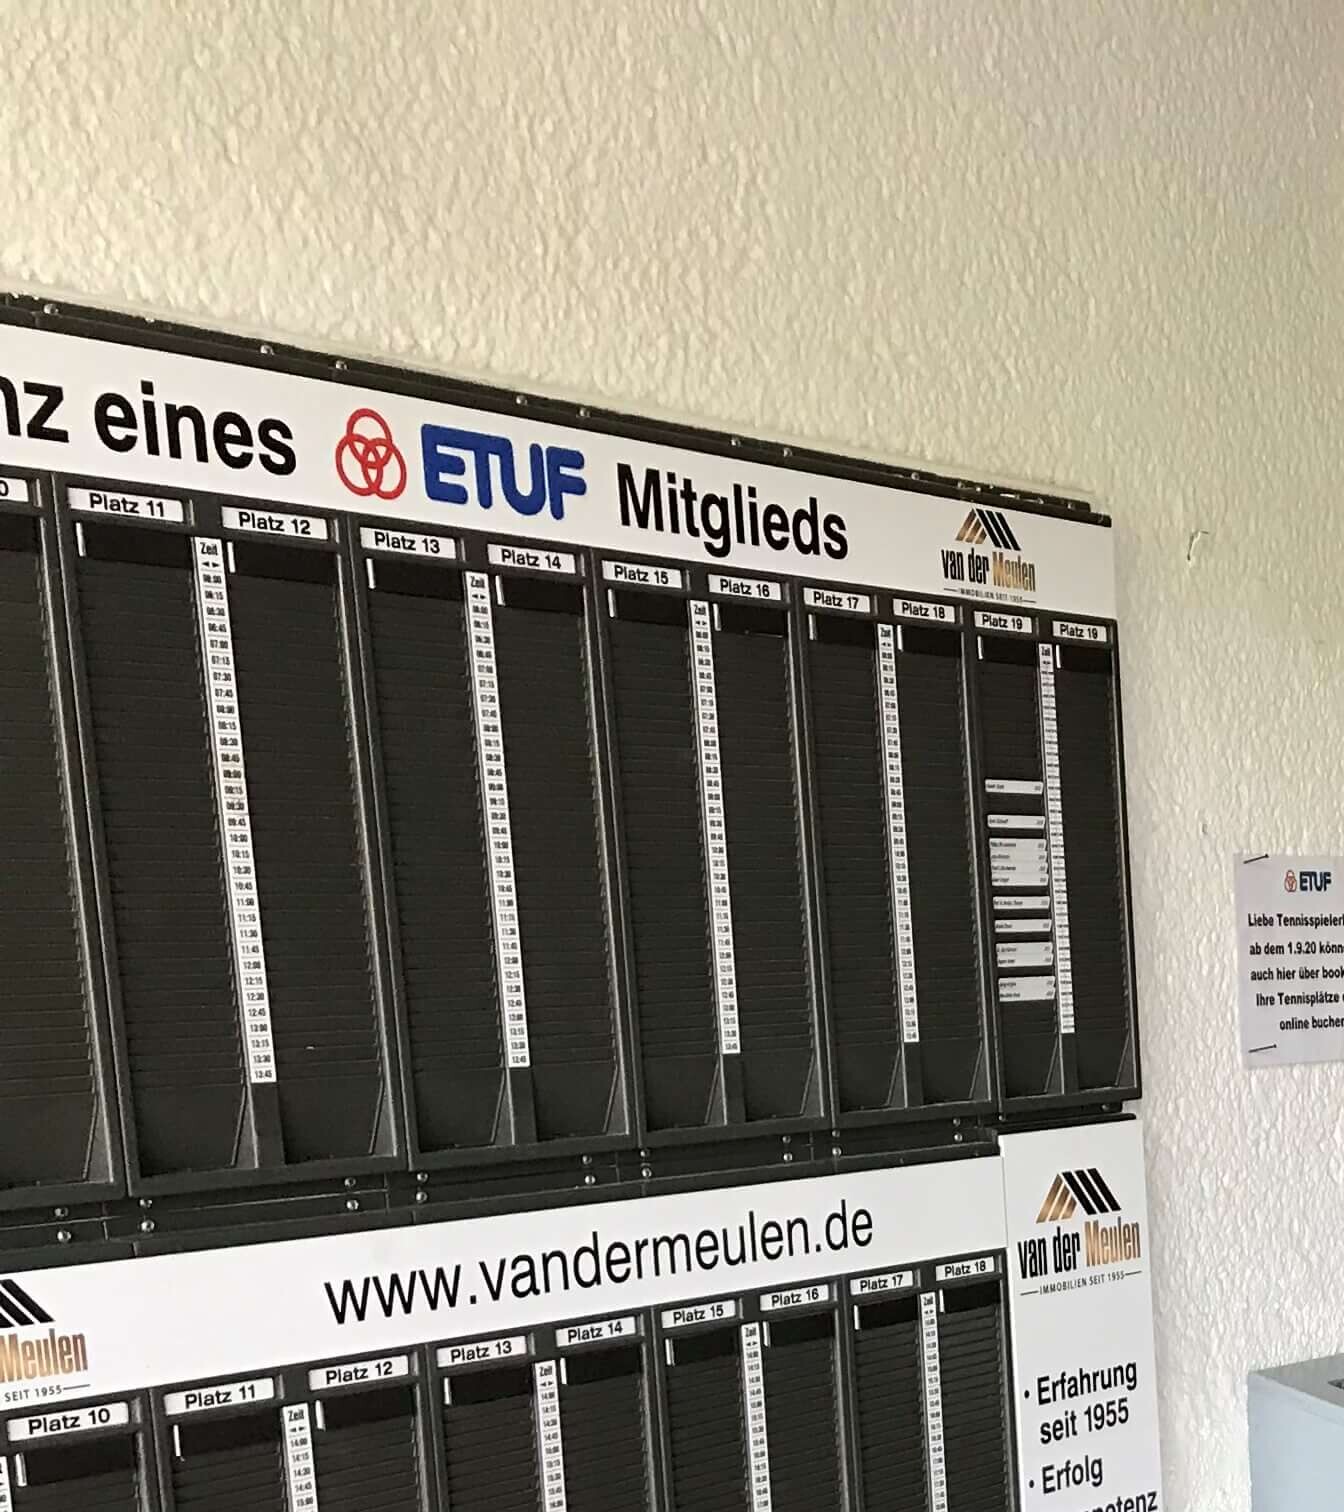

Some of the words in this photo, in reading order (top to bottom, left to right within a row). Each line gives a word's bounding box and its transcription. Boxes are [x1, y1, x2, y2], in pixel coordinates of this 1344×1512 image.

[94, 379, 297, 476] eines
[420, 423, 587, 520] ETUF
[616, 463, 849, 560] Mitglieds
[90, 493, 140, 514] Platz
[147, 500, 164, 517] 11
[239, 512, 284, 532] Platz
[292, 519, 310, 535] 12
[200, 542, 218, 556] Zeit
[374, 531, 416, 550] Platz
[422, 538, 440, 554] 13
[502, 549, 540, 566] Platz
[545, 555, 561, 569] 14
[614, 565, 648, 582] Platz
[654, 571, 668, 584] 15
[941, 549, 964, 581] van
[967, 547, 989, 584] der
[992, 551, 1036, 592] Meulen
[720, 578, 752, 595] Platz
[756, 584, 770, 597] 16
[814, 591, 842, 607] Platz
[847, 597, 858, 609] 17
[902, 602, 929, 616] Platz
[933, 607, 945, 618] 18
[982, 614, 1008, 628] Platz
[1012, 618, 1022, 630] 19
[1060, 624, 1084, 637] Platz
[1088, 628, 1098, 639] 19
[1299, 871, 1332, 891] ETUF
[1248, 913, 1274, 927] Liebe
[1249, 943, 1262, 955] ab
[1264, 942, 1284, 955] dem
[1288, 941, 1316, 954] 1.9.20
[1250, 968, 1273, 981] auch
[1276, 967, 1295, 980] hier
[1299, 966, 1319, 979] über
[1256, 993, 1275, 1006] Ihre
[1278, 991, 1339, 1007] Tennisplätze
[1279, 1017, 1309, 1031] online
[1017, 1236, 1048, 1279] van
[1053, 1226, 1080, 1274] der
[1084, 1216, 1141, 1267] Meulen
[324, 1199, 874, 1326] www.vandermeulen.de
[945, 1264, 970, 1277] Platz
[975, 1260, 986, 1272] 18
[860, 1278, 888, 1291] Platz
[892, 1274, 903, 1286] 17
[1040, 1278, 1087, 1295] IMMOBILIEN
[1089, 1274, 1105, 1286] SEIT
[1108, 1271, 1125, 1283] 1955
[772, 1293, 801, 1306] Platz
[806, 1288, 819, 1300] 16
[674, 1309, 705, 1324] Platz
[710, 1304, 723, 1317] 15
[568, 1327, 602, 1342] Platz
[608, 1321, 622, 1334] 14
[0, 1328, 88, 1383] Meulen
[451, 1346, 490, 1362] Platz
[496, 1341, 512, 1354] 13
[326, 1368, 368, 1384] Platz
[376, 1361, 392, 1376] 12
[539, 1365, 553, 1377] Zeit
[4, 1389, 30, 1402] SEIT
[35, 1385, 62, 1398] 1955
[1037, 1362, 1137, 1405] Erfahrung
[185, 1391, 232, 1408] Platz
[240, 1384, 254, 1400] 11
[28, 1416, 80, 1434] Platz
[88, 1408, 110, 1424] 10
[288, 1409, 305, 1422] Zeit
[1040, 1410, 1077, 1444] seit
[1083, 1397, 1129, 1432] 1955
[1042, 1455, 1103, 1494] Erfolg
